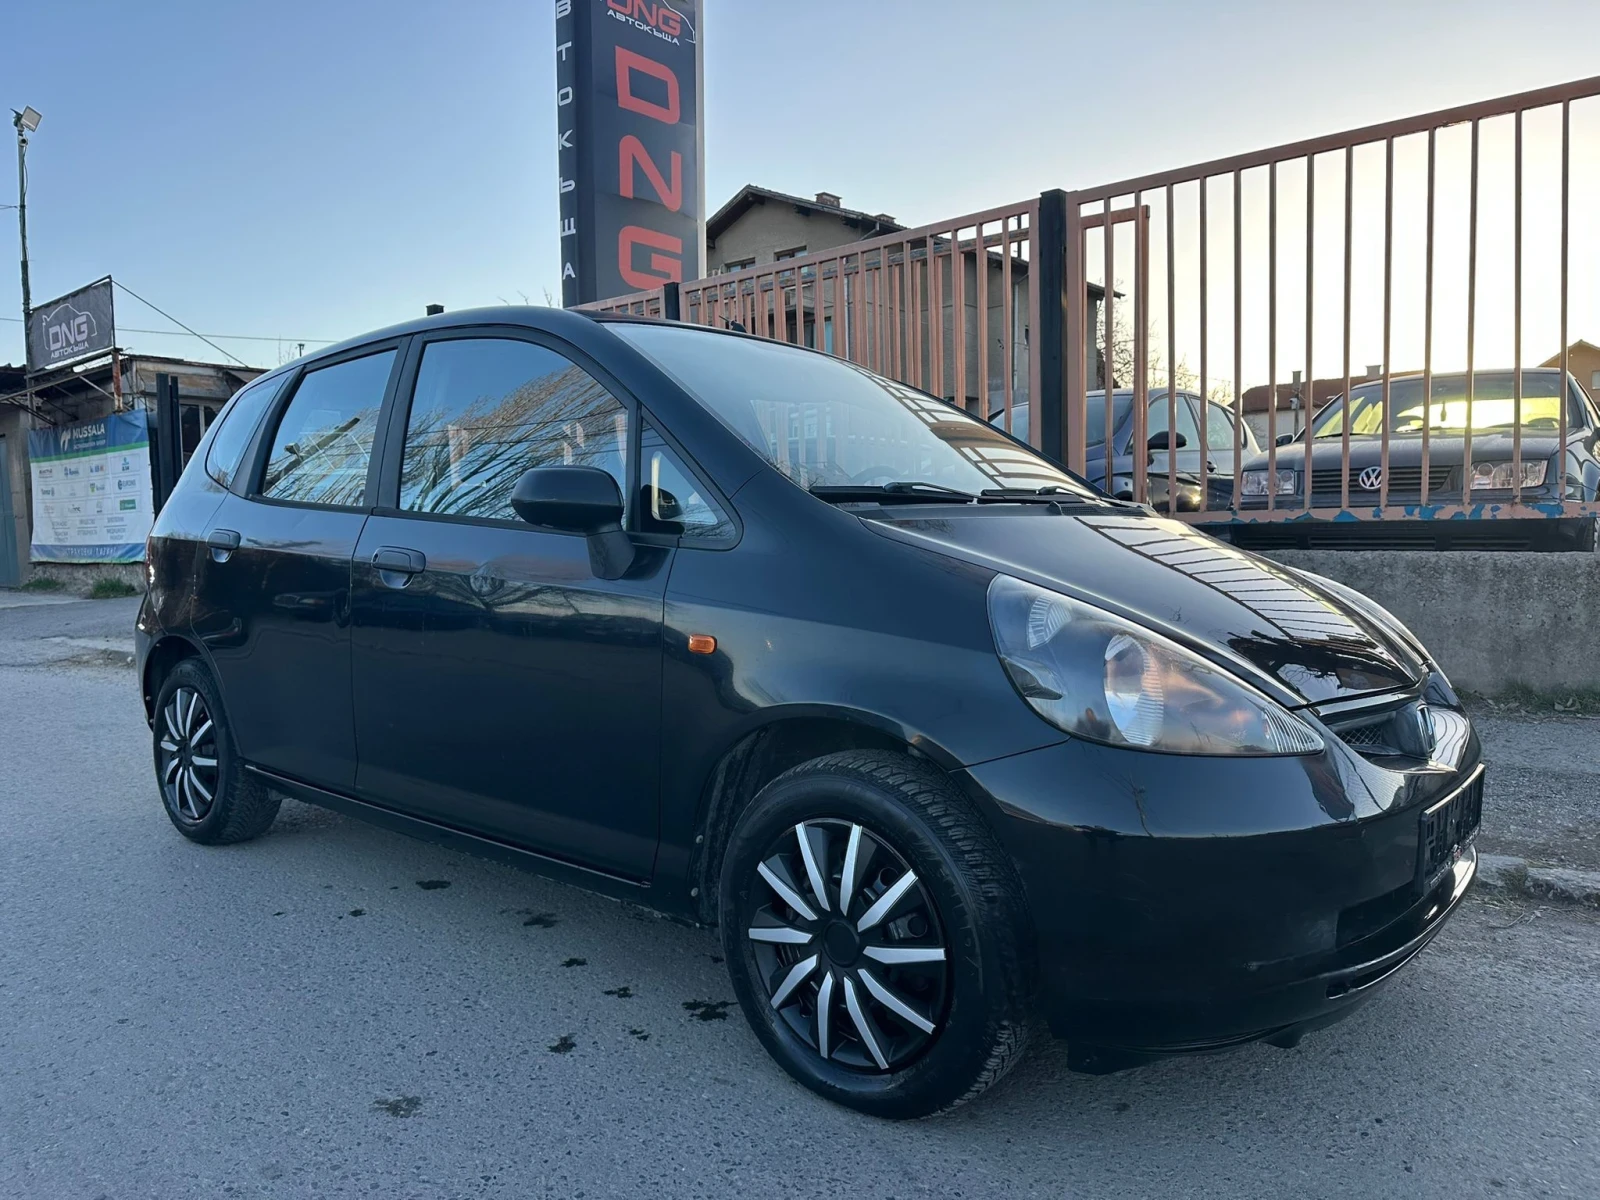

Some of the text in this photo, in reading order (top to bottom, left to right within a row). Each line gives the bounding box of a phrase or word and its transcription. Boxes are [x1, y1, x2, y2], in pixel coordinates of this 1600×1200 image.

[607, 9, 680, 46] АВТОКЪЩА
[615, 45, 682, 291] DNG
[49, 315, 88, 351] DNG
[51, 341, 89, 359] АВТОКЪЩА
[72, 423, 105, 439] MUSSALA
